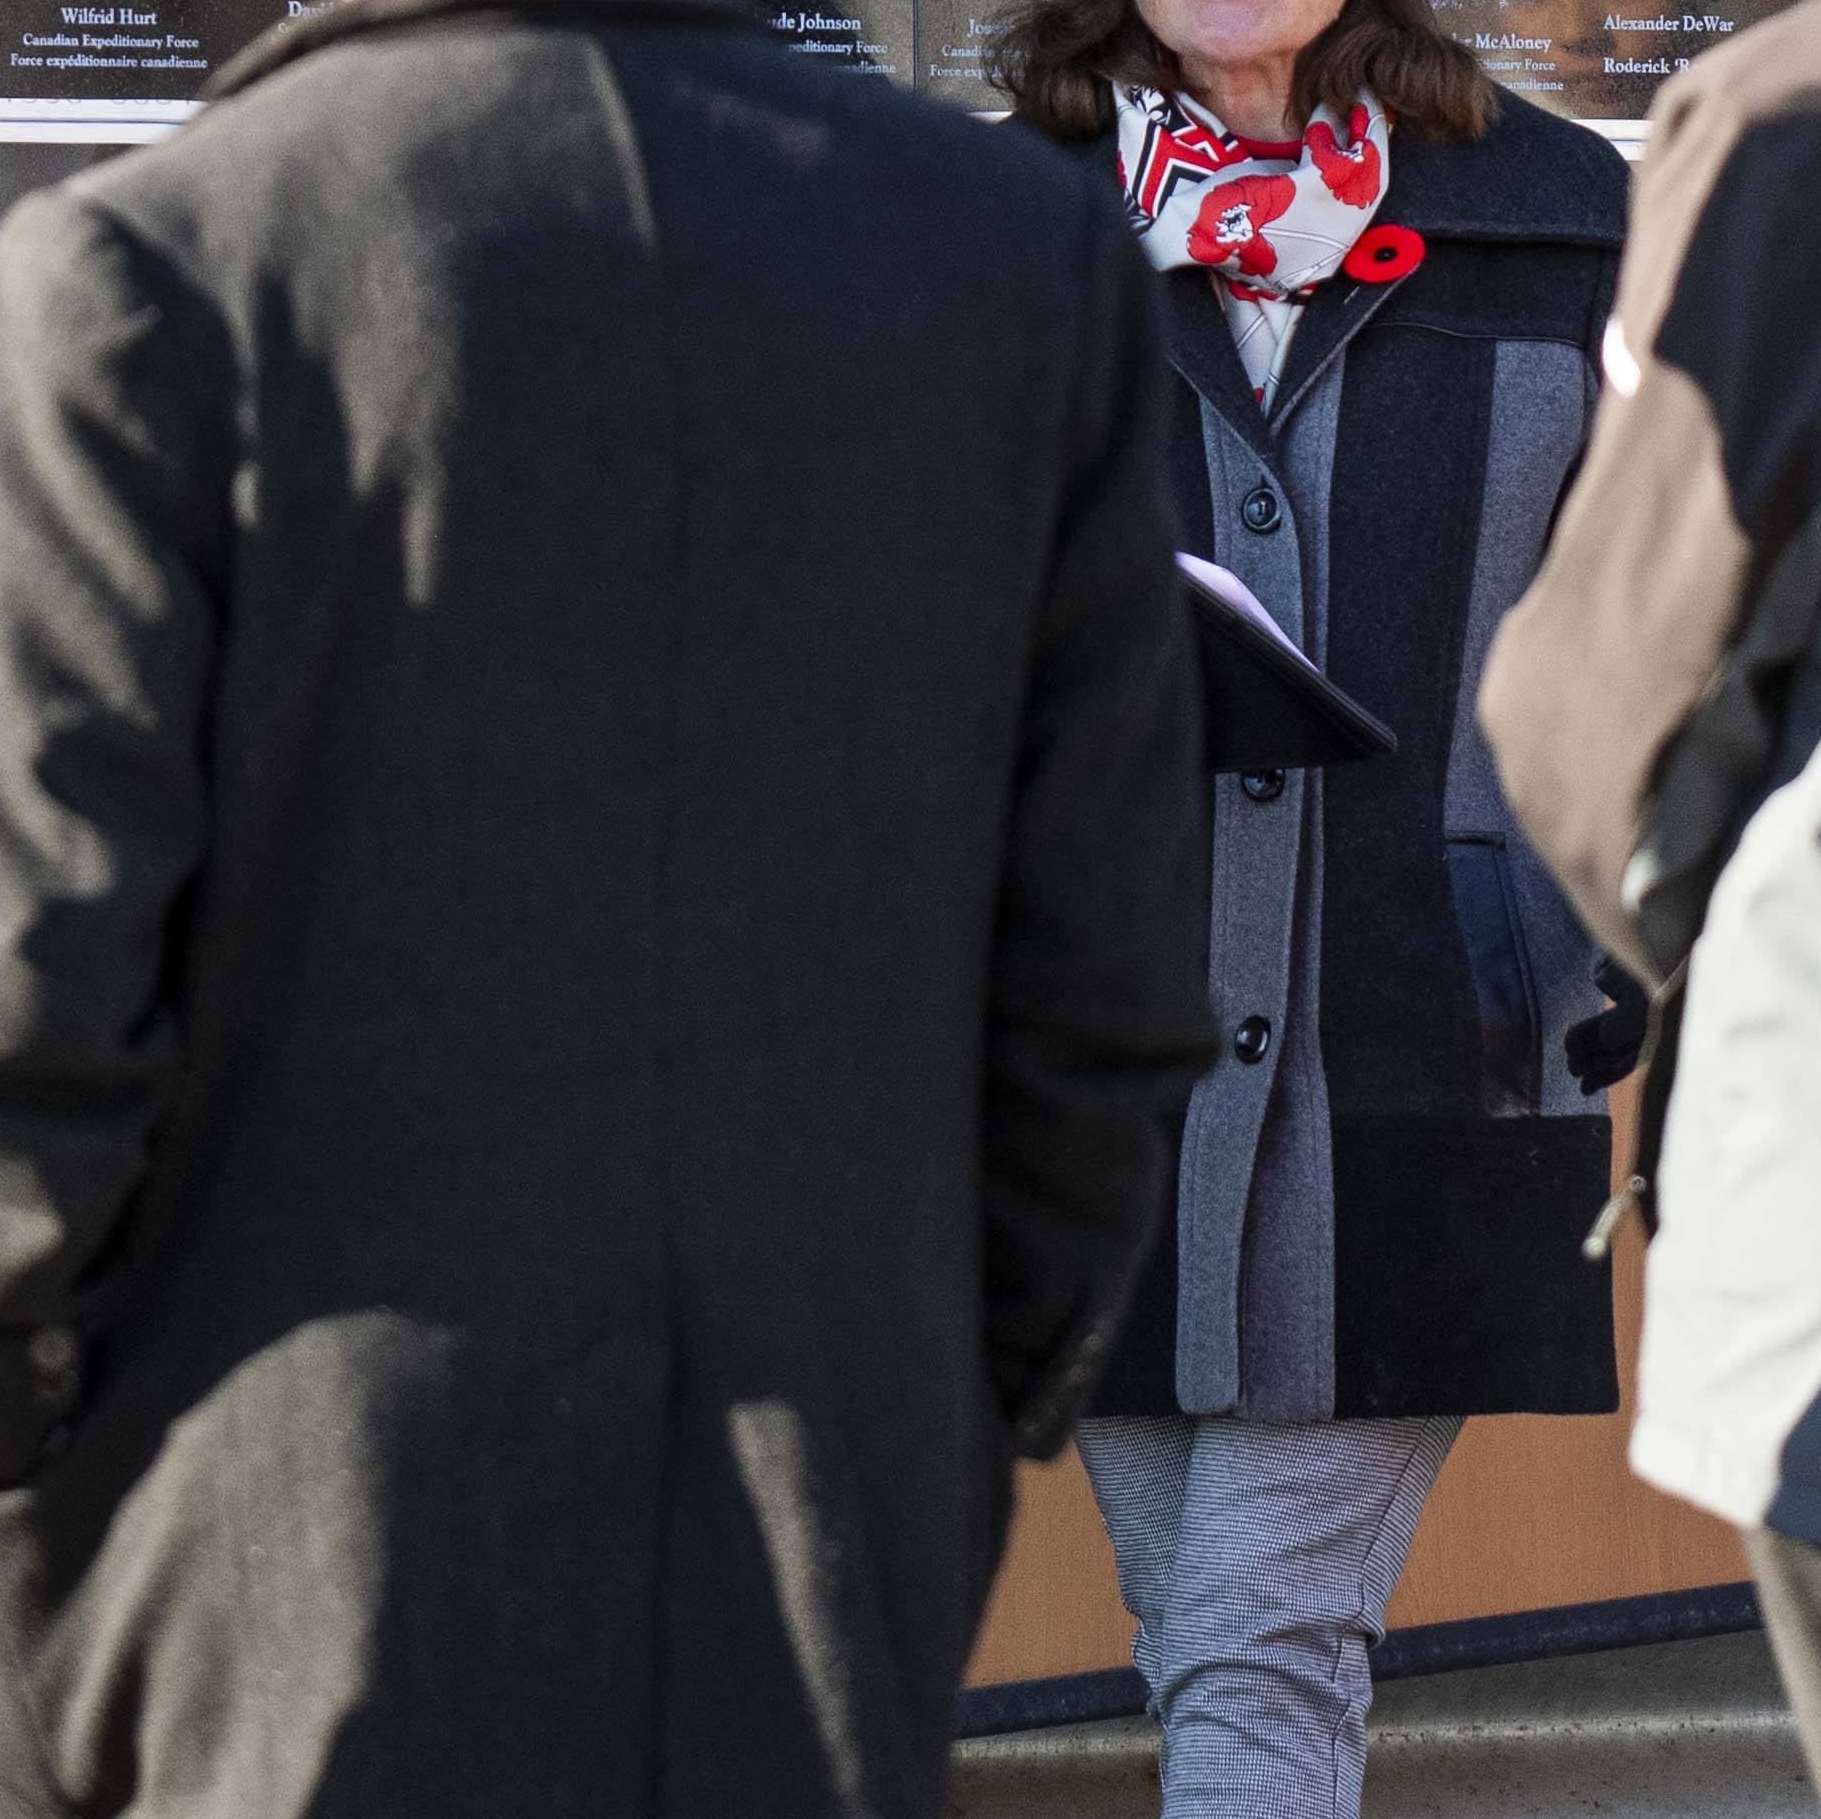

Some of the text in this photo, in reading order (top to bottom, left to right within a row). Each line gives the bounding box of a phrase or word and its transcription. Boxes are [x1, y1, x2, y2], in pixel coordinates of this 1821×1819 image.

[60, 7, 157, 25] Wilfrid Hurt
[1603, 13, 1734, 31] Alexander DeWar
